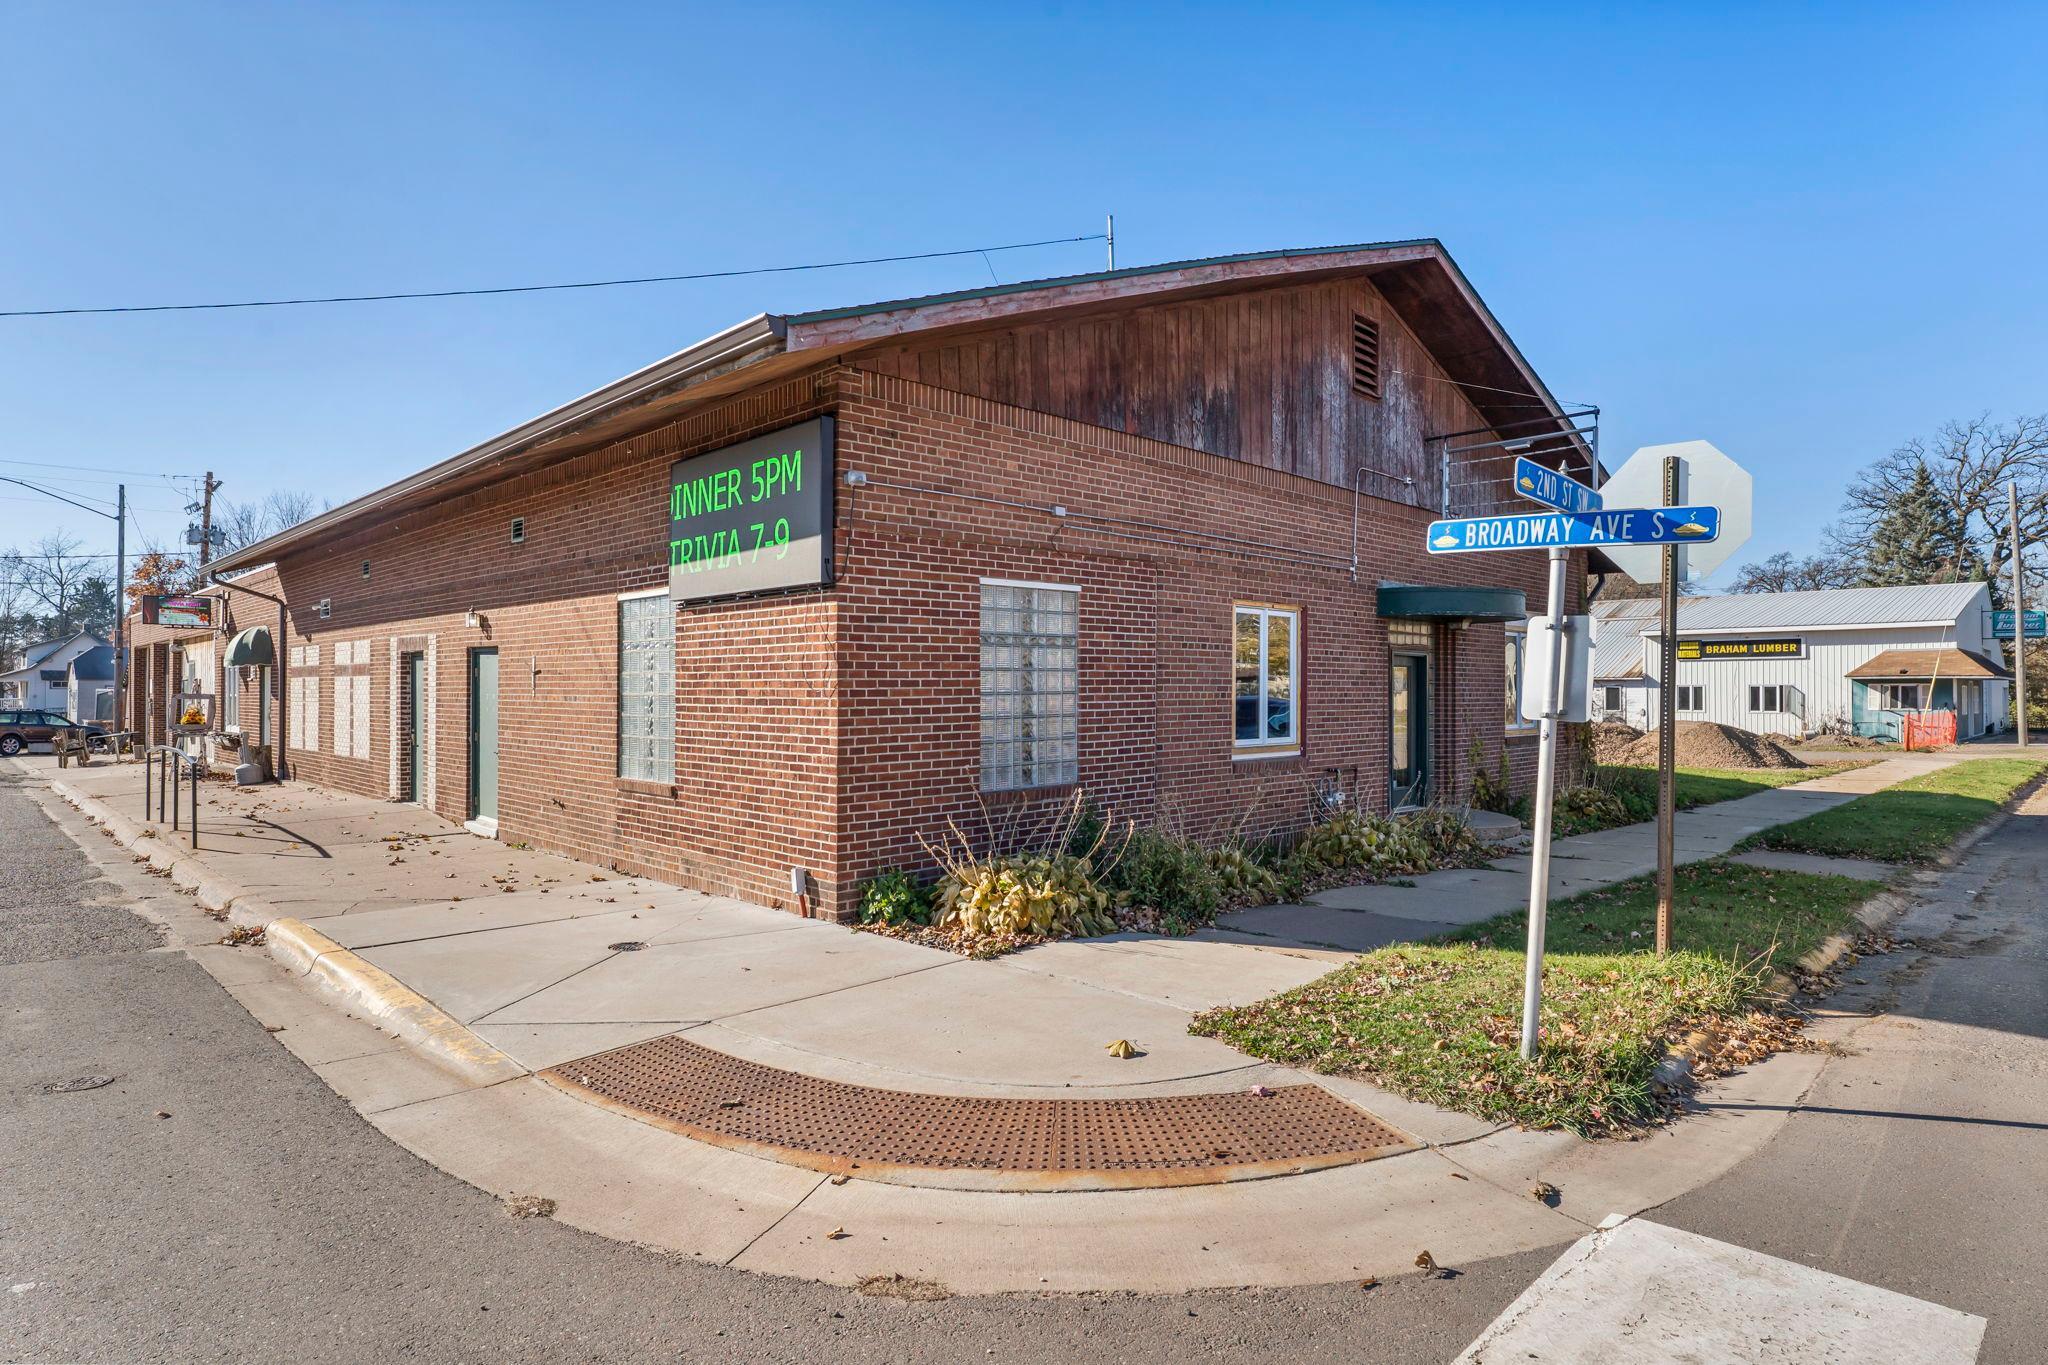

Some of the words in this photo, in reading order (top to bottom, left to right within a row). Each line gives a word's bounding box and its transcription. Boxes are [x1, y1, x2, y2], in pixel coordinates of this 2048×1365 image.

[670, 468, 743, 521] INNER
[751, 450, 801, 503] 5PM
[1536, 469, 1557, 501] 2ND
[1562, 481, 1573, 508] ST
[1576, 487, 1589, 512] SW
[670, 528, 742, 576] TRIVIA
[750, 518, 790, 565] 7-9
[1465, 517, 1575, 547] BROADWAY
[1589, 513, 1635, 541] AVE
[1651, 511, 1665, 539] S
[1706, 645, 1748, 654] BRAHAM
[1753, 643, 1797, 653] LUMBER
